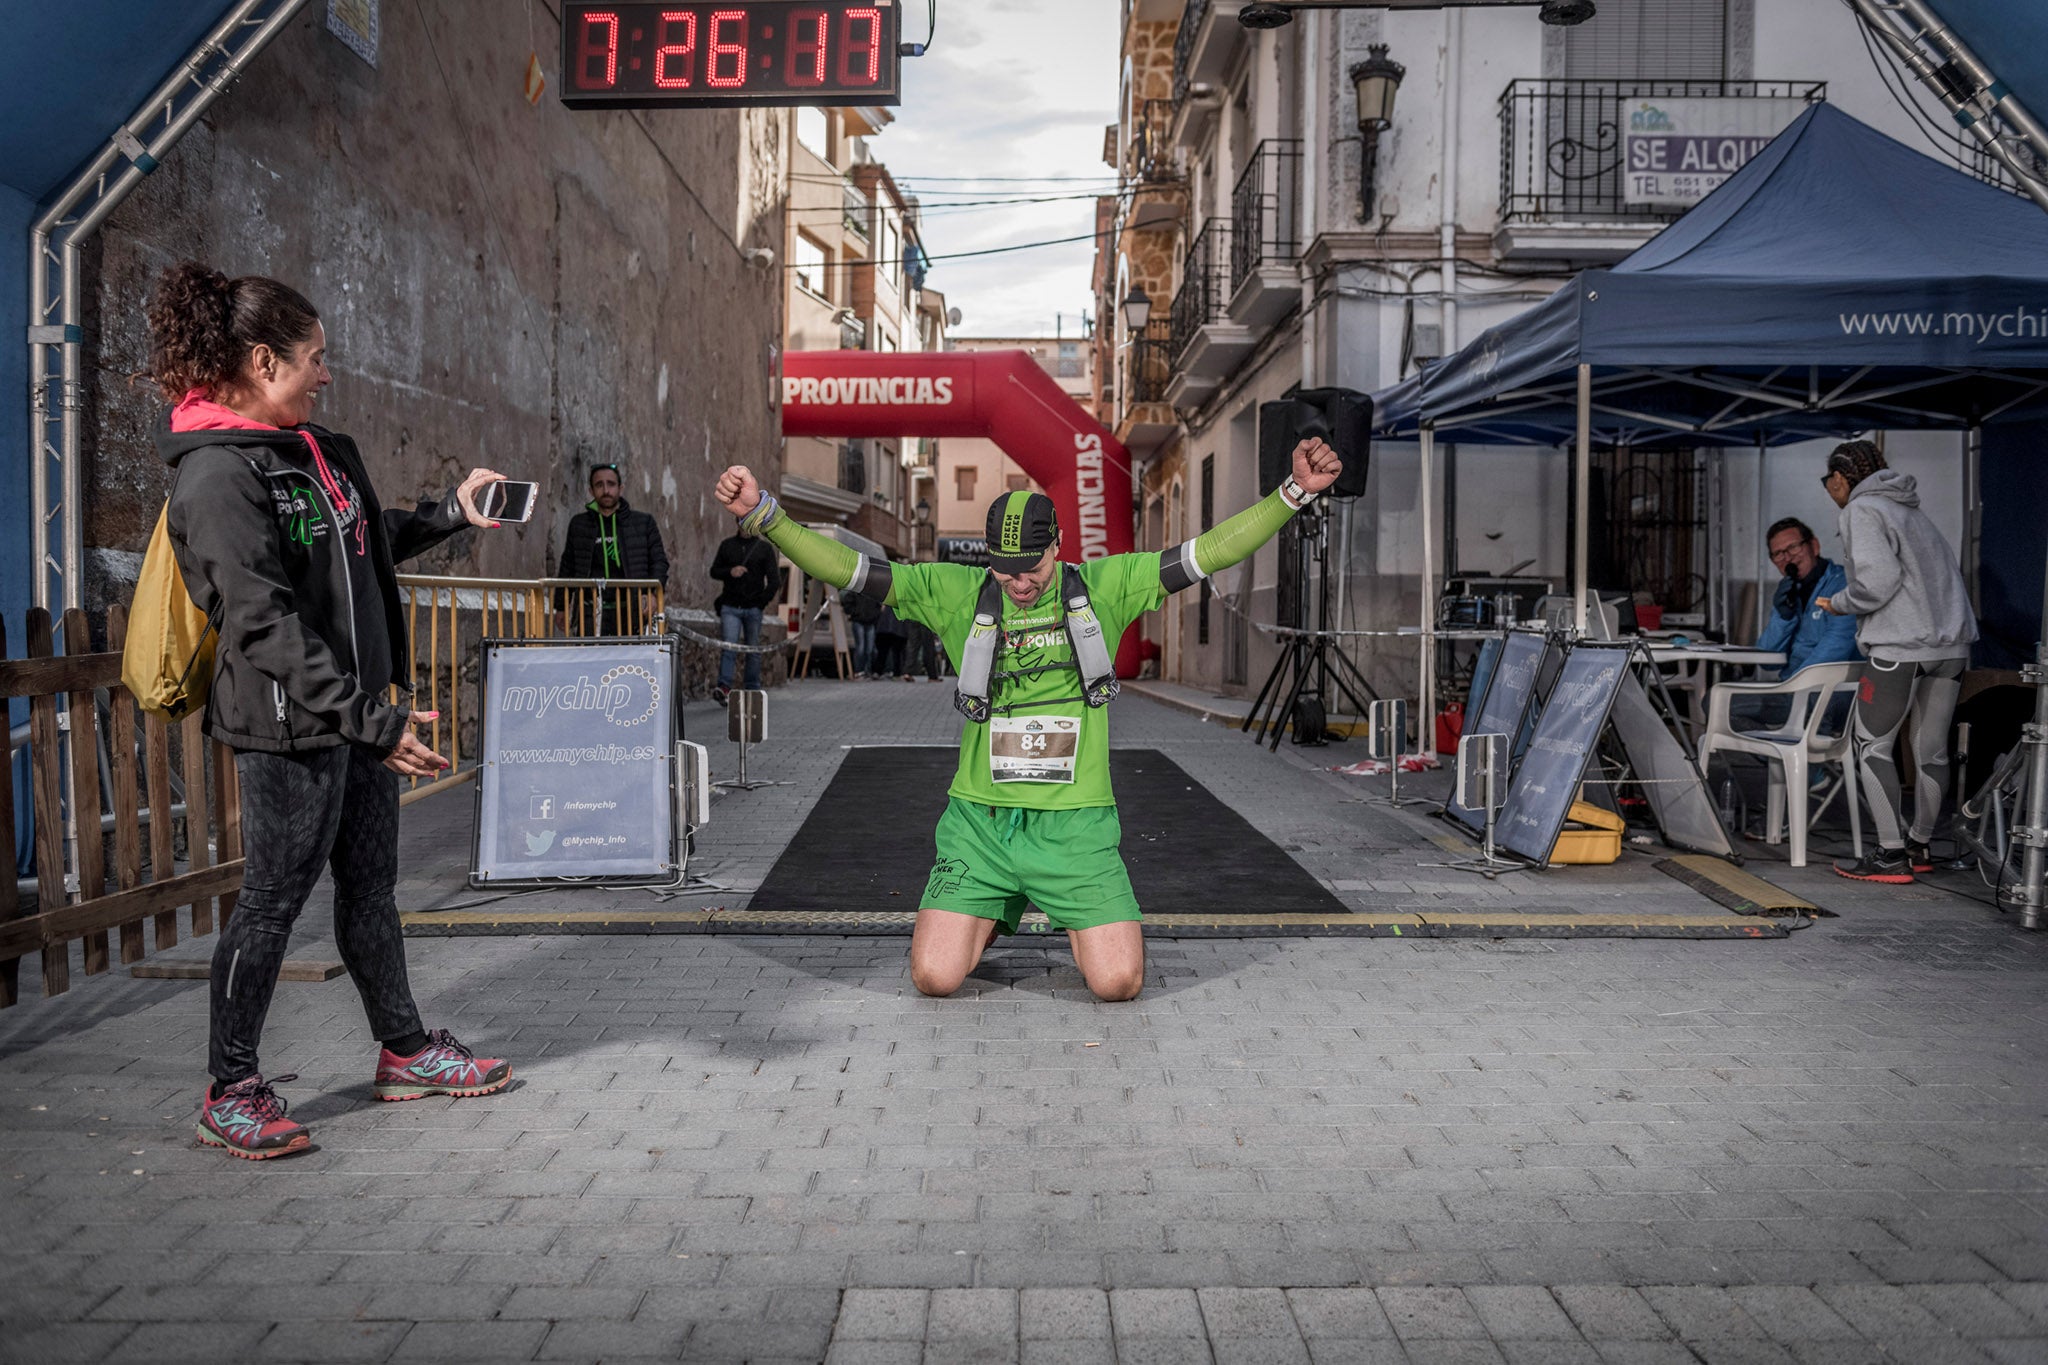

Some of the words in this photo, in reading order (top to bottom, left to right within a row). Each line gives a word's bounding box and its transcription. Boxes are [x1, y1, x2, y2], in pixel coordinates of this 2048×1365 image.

[1632, 139, 1667, 170] SE
[1674, 177, 1700, 187] 651
[782, 376, 953, 405] PROVINCIAS
[1003, 514, 1013, 546] GREEN
[1011, 514, 1021, 547] POWER
[502, 676, 632, 719] mychip
[500, 743, 656, 767] www.mychip.es
[1021, 734, 1047, 750] 84
